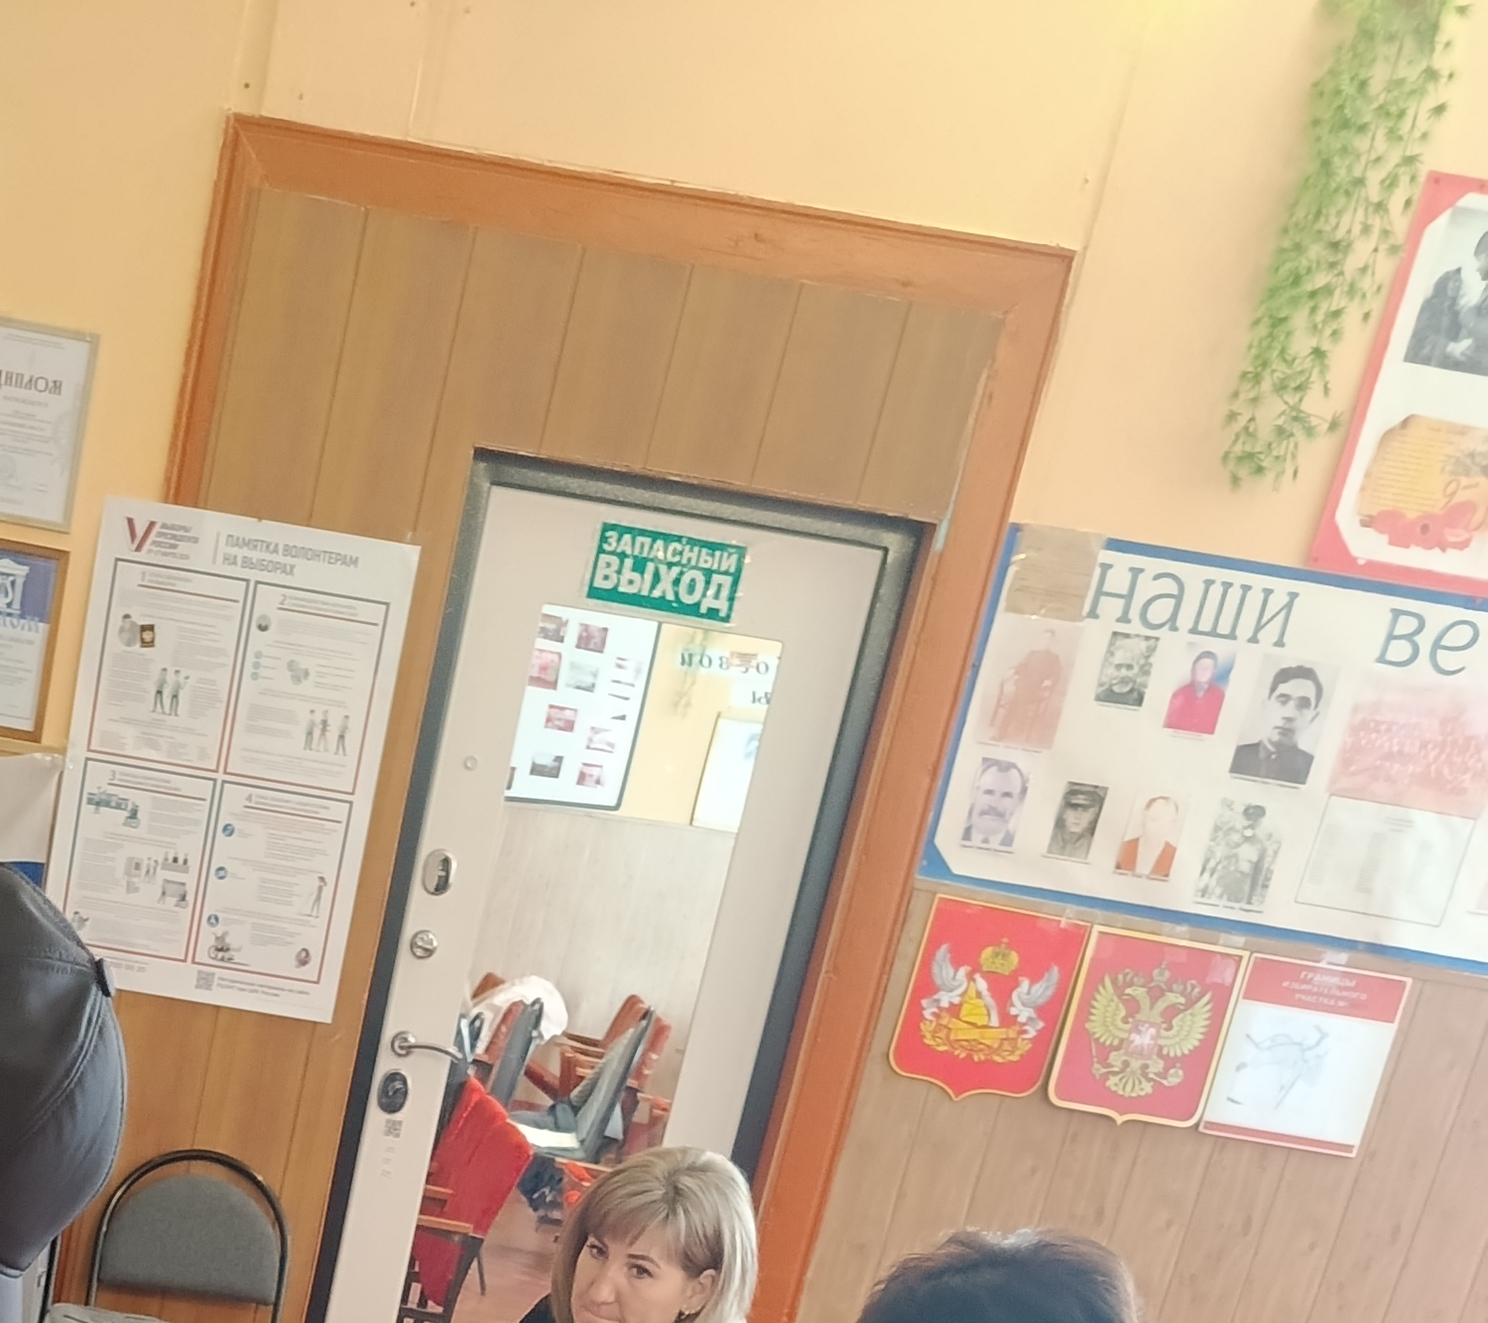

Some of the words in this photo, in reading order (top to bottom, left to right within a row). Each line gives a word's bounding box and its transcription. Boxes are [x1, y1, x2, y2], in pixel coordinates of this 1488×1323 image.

[222, 552, 239, 568] НА
[241, 556, 296, 577] ВЫБОРАХ
[225, 534, 280, 554] ПАМЯТКА
[282, 543, 359, 568] ВОЛОНТЕРАМ
[602, 530, 739, 574] ЗАПАСНЫЙ
[592, 555, 733, 617] ВЫХОД
